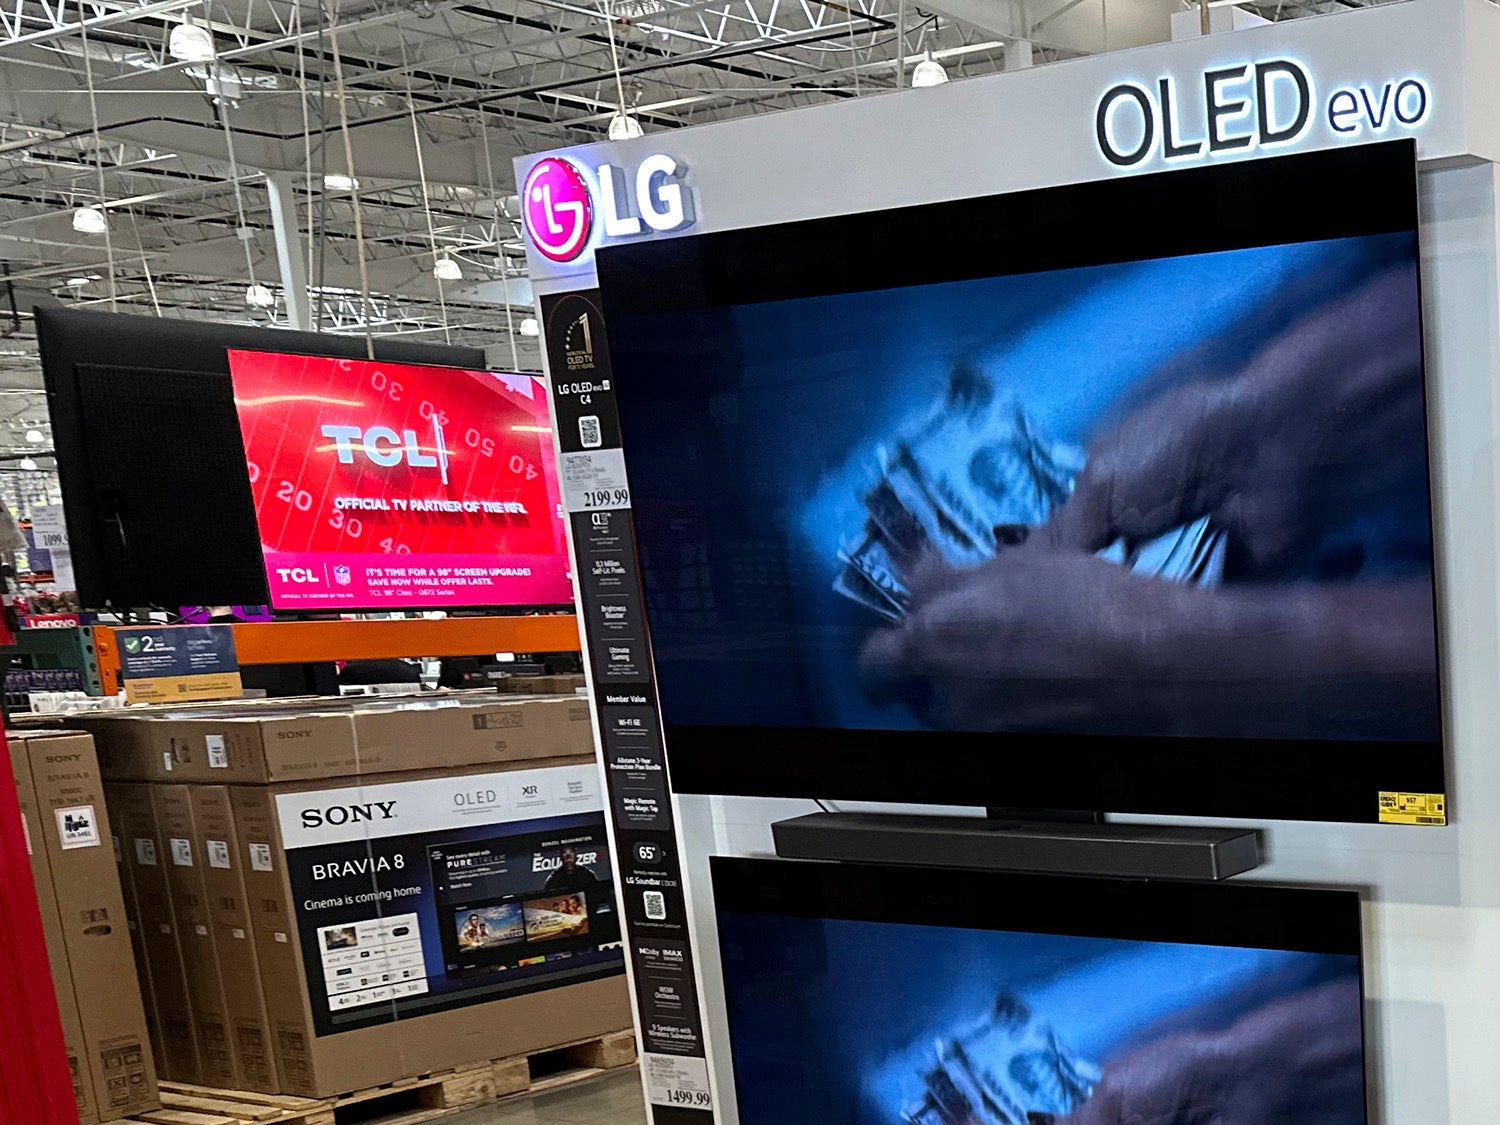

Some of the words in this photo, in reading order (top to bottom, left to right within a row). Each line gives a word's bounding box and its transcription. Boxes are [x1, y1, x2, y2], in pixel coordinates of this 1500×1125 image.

[1096, 60, 1311, 166] OLED
[1328, 79, 1427, 132] evo
[598, 154, 690, 236] LG
[567, 355, 584, 365] OLED
[584, 354, 593, 363] TV
[558, 384, 570, 395] LG
[570, 382, 593, 394] OLED
[580, 394, 592, 405] C4
[321, 424, 437, 468] TCL
[276, 480, 313, 512] 20
[584, 488, 629, 507] 2199.99
[334, 497, 390, 511] OFFICIAL
[391, 499, 407, 511] TV
[410, 499, 462, 513] PARTNER
[463, 501, 481, 513] OF
[482, 501, 506, 513] THE
[505, 502, 528, 514] NFL
[328, 509, 364, 538] 30
[276, 568, 319, 583] TCL
[366, 568, 383, 577] IT'S
[384, 568, 406, 577] TIME
[408, 568, 427, 577] FOR
[429, 568, 435, 577] A
[454, 568, 488, 577] SCREEN
[489, 568, 531, 577] UPGRADE!
[367, 578, 390, 586] SAVE
[390, 578, 409, 586] NOW
[410, 578, 440, 586] WHILE
[441, 578, 467, 586] OFFER
[468, 577, 494, 586] LASTS.
[29, 616, 77, 627] Lenovo
[141, 635, 155, 652] 2
[606, 695, 629, 703] Member
[631, 695, 647, 703] Value
[278, 729, 312, 740] SONY
[46, 753, 81, 763] SONY
[454, 789, 497, 806] OLED
[300, 801, 397, 829] SONY
[312, 856, 392, 880] BRAVIA
[394, 854, 404, 869] 8
[532, 852, 597, 873] EQUZER
[626, 876, 634, 884] LG
[304, 895, 343, 911] Cinema
[345, 894, 353, 905] is
[354, 888, 392, 904] coming
[393, 884, 422, 898] home
[662, 949, 683, 957] IMAX
[667, 1089, 710, 1105] 1499.99
